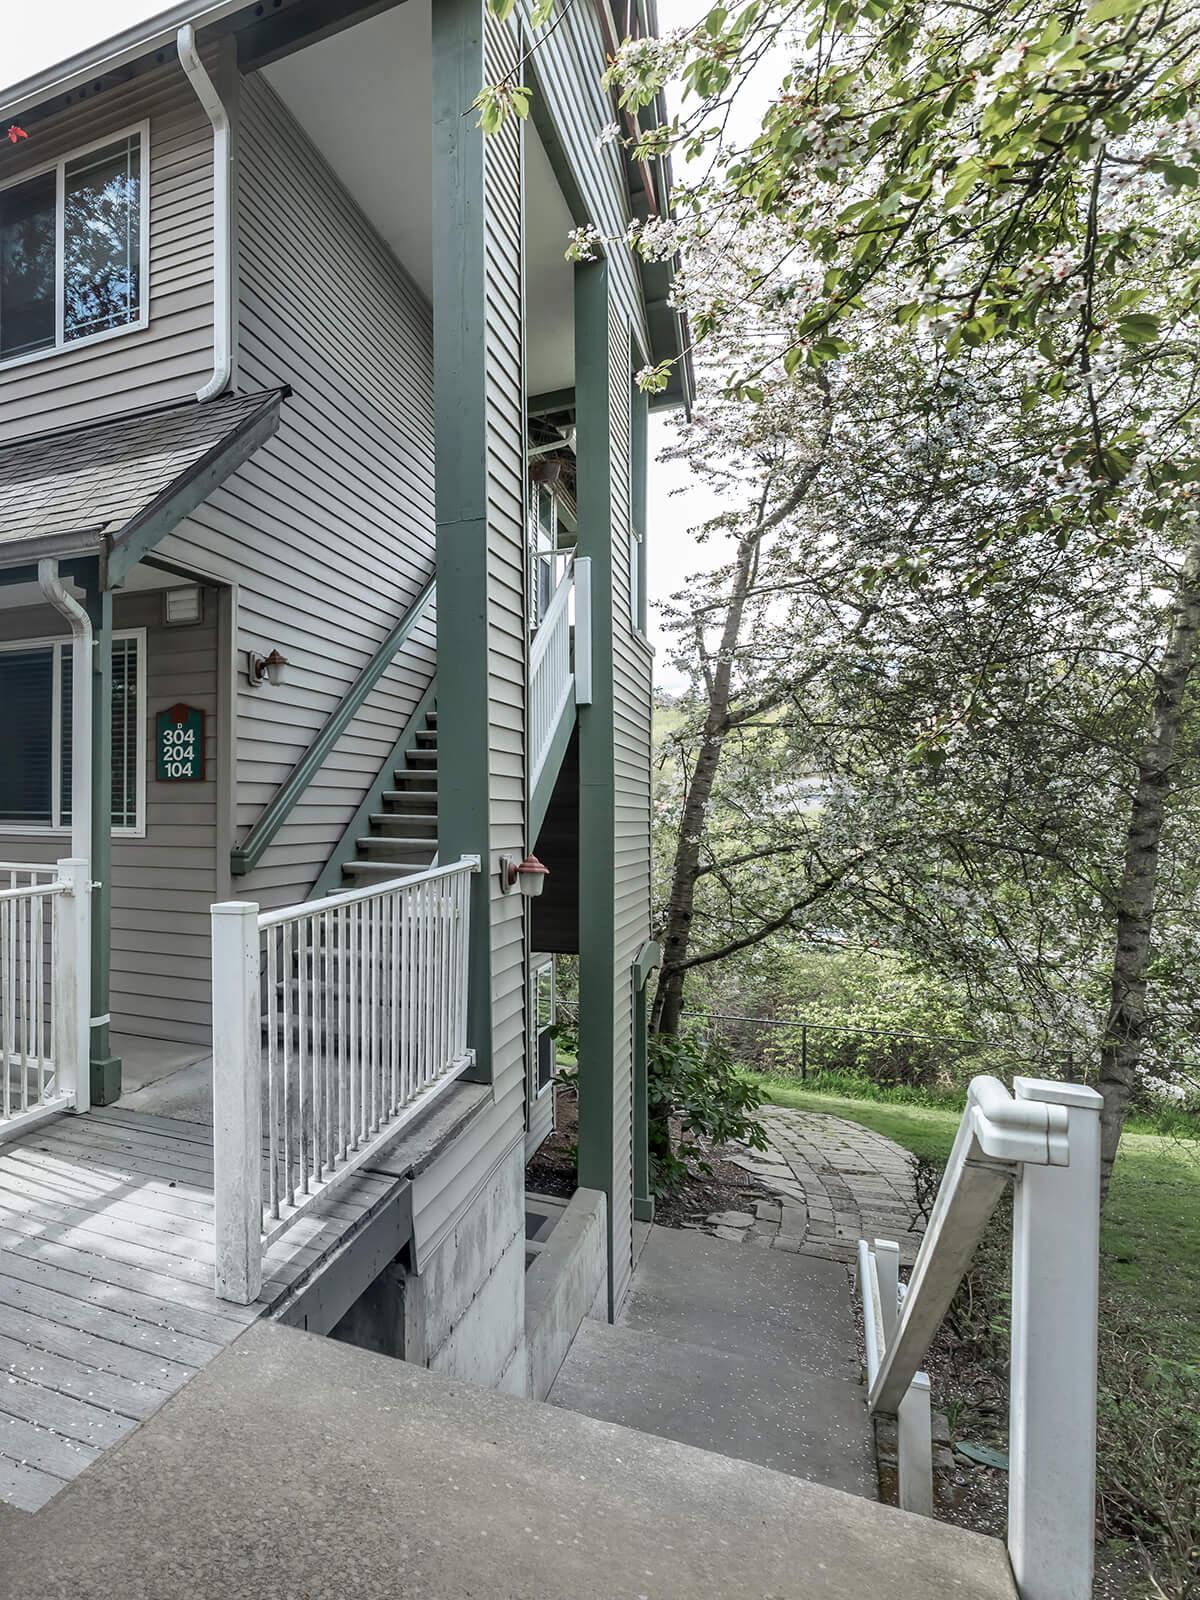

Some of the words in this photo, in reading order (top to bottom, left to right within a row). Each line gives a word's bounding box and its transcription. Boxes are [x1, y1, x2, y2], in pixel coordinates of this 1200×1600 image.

[163, 729, 195, 745] 304
[163, 745, 195, 761] 204
[164, 762, 193, 777] 104
